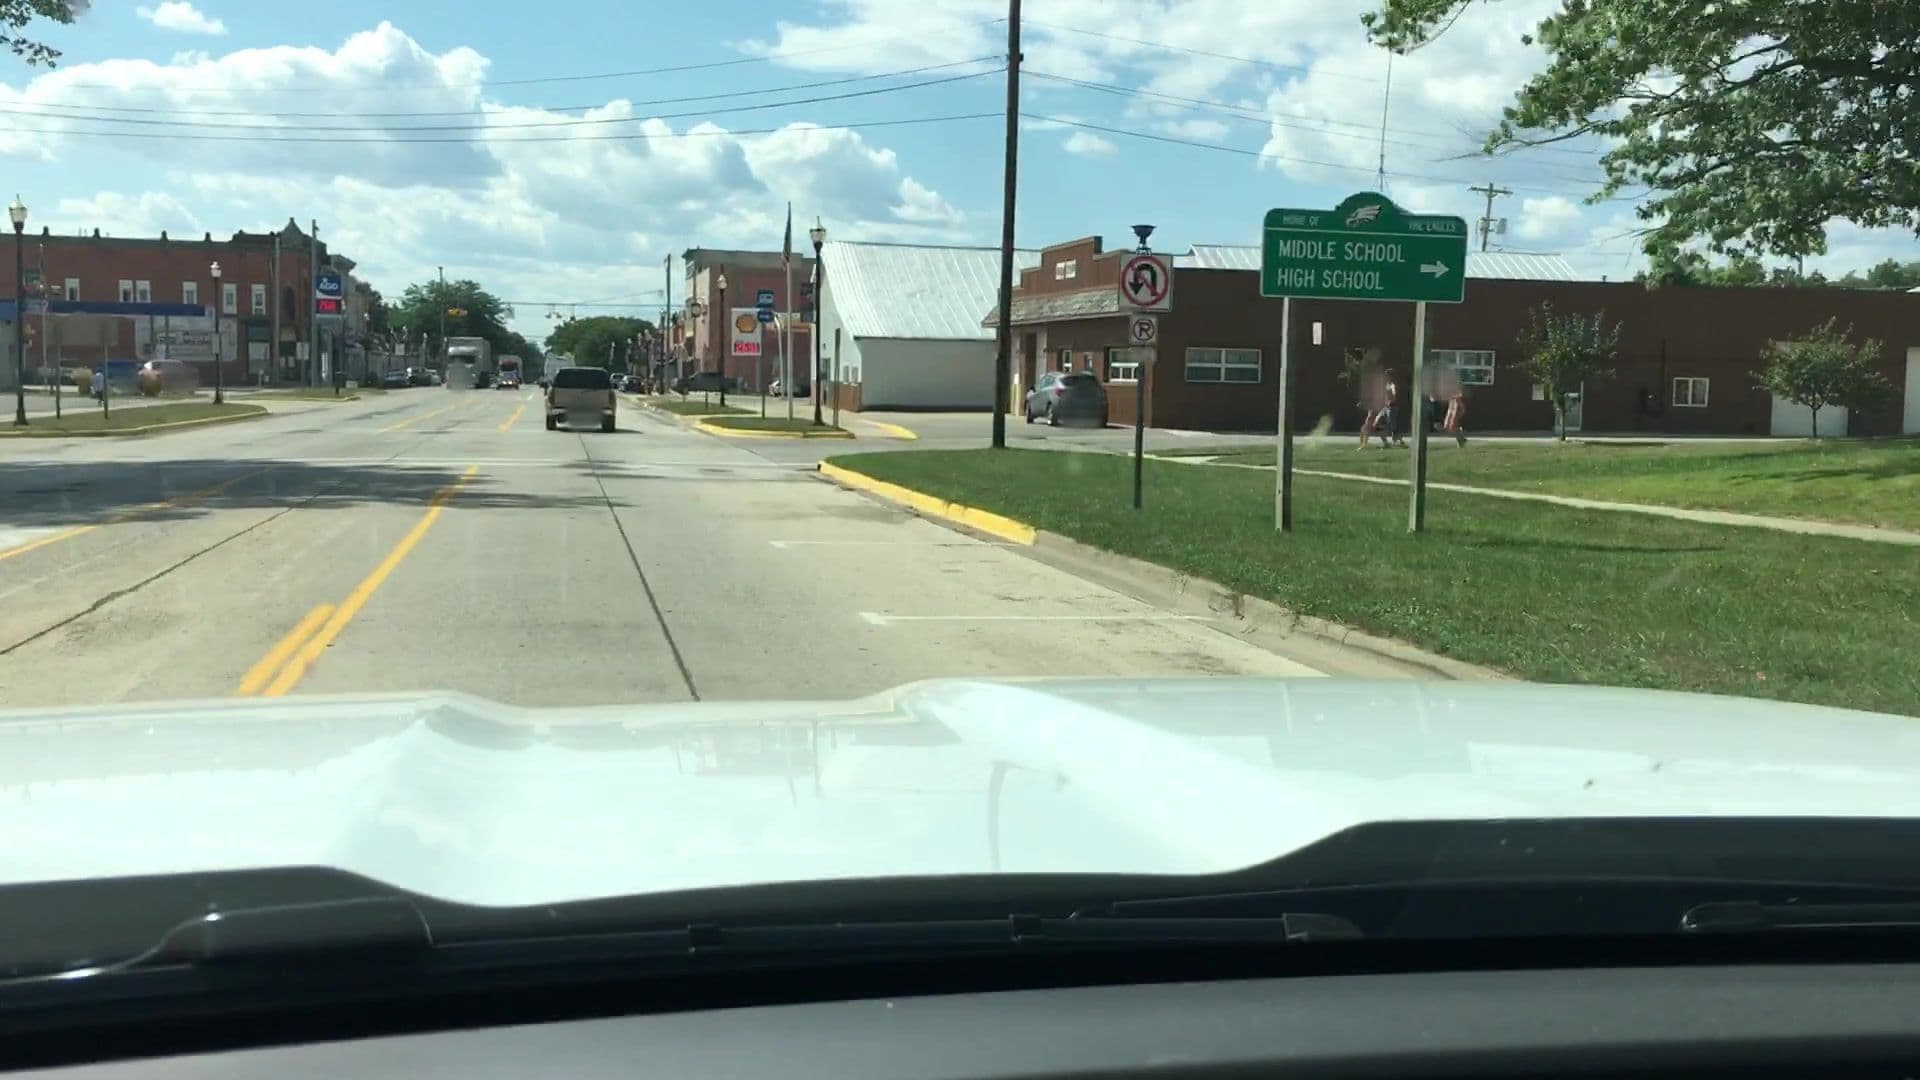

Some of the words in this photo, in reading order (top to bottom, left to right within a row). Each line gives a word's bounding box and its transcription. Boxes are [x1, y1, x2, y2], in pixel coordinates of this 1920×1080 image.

[1309, 215, 1321, 226] OF
[1279, 239, 1337, 260] MIDDLE
[1344, 241, 1406, 262] SCHOOL
[1277, 268, 1315, 288] HIGH
[1322, 271, 1385, 290] SCHOOL
